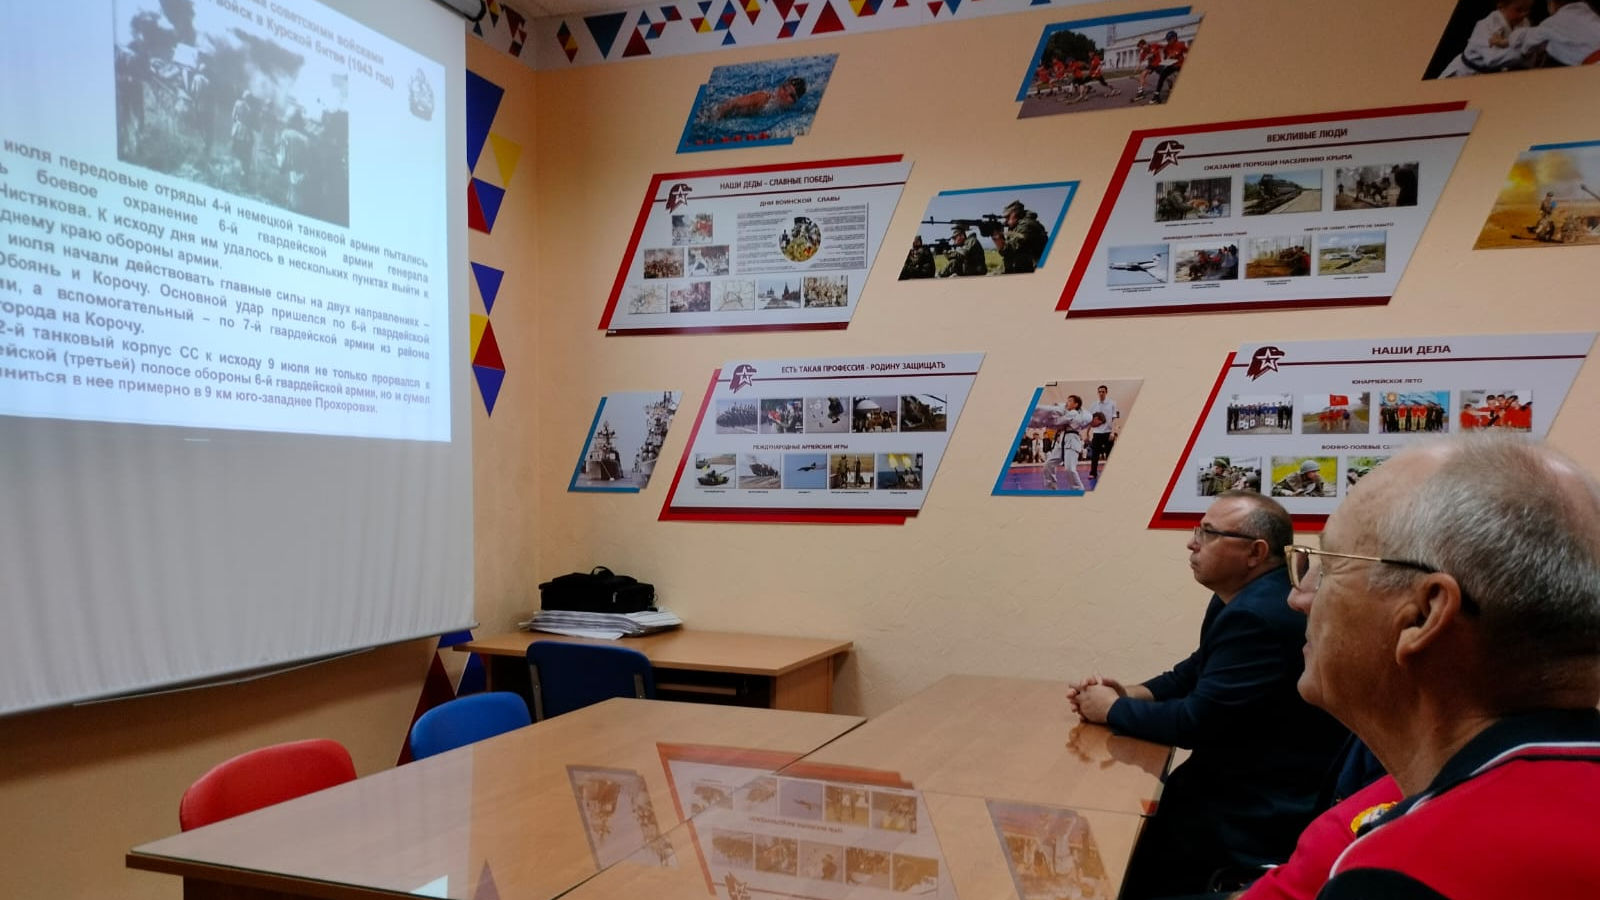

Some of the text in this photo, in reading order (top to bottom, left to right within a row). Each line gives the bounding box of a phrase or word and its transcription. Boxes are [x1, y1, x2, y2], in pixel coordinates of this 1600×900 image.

[267, 16, 312, 47] Курской
[1266, 128, 1348, 143] ВЕЖЛИВЫЕ ЛЮДИ
[720, 182, 742, 190] НАШИ
[743, 180, 762, 189] ДЕДЫ
[769, 177, 802, 187] СЛАВНЫЕ
[804, 175, 834, 184] ПОБЕДЫ
[1204, 153, 1353, 171] ОКАЗАНИЕ ПОМОЩИ НАСЕЛЕНИЮ КРЫМА
[4, 139, 428, 268] июля передовые отряды 4-й немецкой танковой армии пытались
[37, 170, 429, 284] боевое охранение 6-й гвардейской армии генерала
[0, 183, 92, 218] Чистякова.
[98, 207, 108, 222] К
[114, 213, 165, 238] исходу
[170, 228, 195, 244] дня
[201, 236, 218, 249] им
[223, 242, 273, 263] удалось
[277, 255, 285, 265] в
[289, 258, 349, 280] нескольких
[352, 272, 388, 290] пунктах
[392, 282, 420, 297] выйти
[61, 222, 102, 243] краю
[106, 233, 173, 259] обороны
[177, 249, 223, 269] армии.
[8, 234, 55, 254] июля
[63, 245, 119, 267] начали
[125, 258, 215, 287] действовать
[220, 279, 272, 299] главные
[276, 289, 306, 305] силы
[311, 297, 323, 309] на
[326, 301, 351, 315] двух
[355, 306, 419, 328] направлениях
[0, 300, 145, 336] орода на Корочу.
[33, 284, 42, 295] а
[58, 288, 194, 321] вспомогательный
[219, 316, 235, 328] по
[244, 318, 262, 333] 7-й
[270, 325, 337, 345] гвардейской
[344, 338, 375, 352] армии
[380, 345, 391, 354] из
[398, 347, 430, 362] района
[72, 269, 80, 280] и
[93, 270, 150, 295] Корочу.
[160, 284, 227, 307] Основной
[235, 300, 264, 318] удар
[272, 307, 326, 325] пришелся
[333, 318, 345, 329] по
[351, 320, 366, 333] 6-й
[373, 326, 429, 344] гвардейской
[32, 326, 115, 349] танковый
[122, 339, 172, 358] корпус
[179, 346, 199, 360] СС
[205, 352, 212, 362] к
[219, 354, 262, 371] исходу
[267, 358, 275, 370] 9
[280, 362, 310, 375] июля
[315, 366, 328, 377] не
[332, 368, 368, 382] только
[371, 373, 420, 390] прорвался
[781, 365, 798, 374] ЕСТЬ
[800, 365, 822, 373] ТАКАЯ
[823, 363, 865, 373] ПРОФЕССИЯ
[870, 362, 900, 371] РОДИНУ
[902, 361, 946, 371] ЗАЩИЩАТЬ
[1372, 345, 1451, 356] НАШИ ДЕЛА
[63, 350, 136, 373] (третьей)
[141, 362, 191, 378] полосе
[195, 369, 251, 385] обороны
[255, 373, 272, 386] 6-й
[276, 379, 343, 396] гвардейской
[345, 387, 378, 400] армии,
[380, 390, 392, 400] но
[73, 375, 82, 386] в
[86, 376, 114, 389] нее
[118, 379, 190, 398] примерно
[194, 386, 201, 397] в
[205, 386, 212, 398] 9
[215, 389, 232, 400] км
[235, 390, 312, 408] юго-западнее
[315, 395, 378, 414] Прохоровки.
